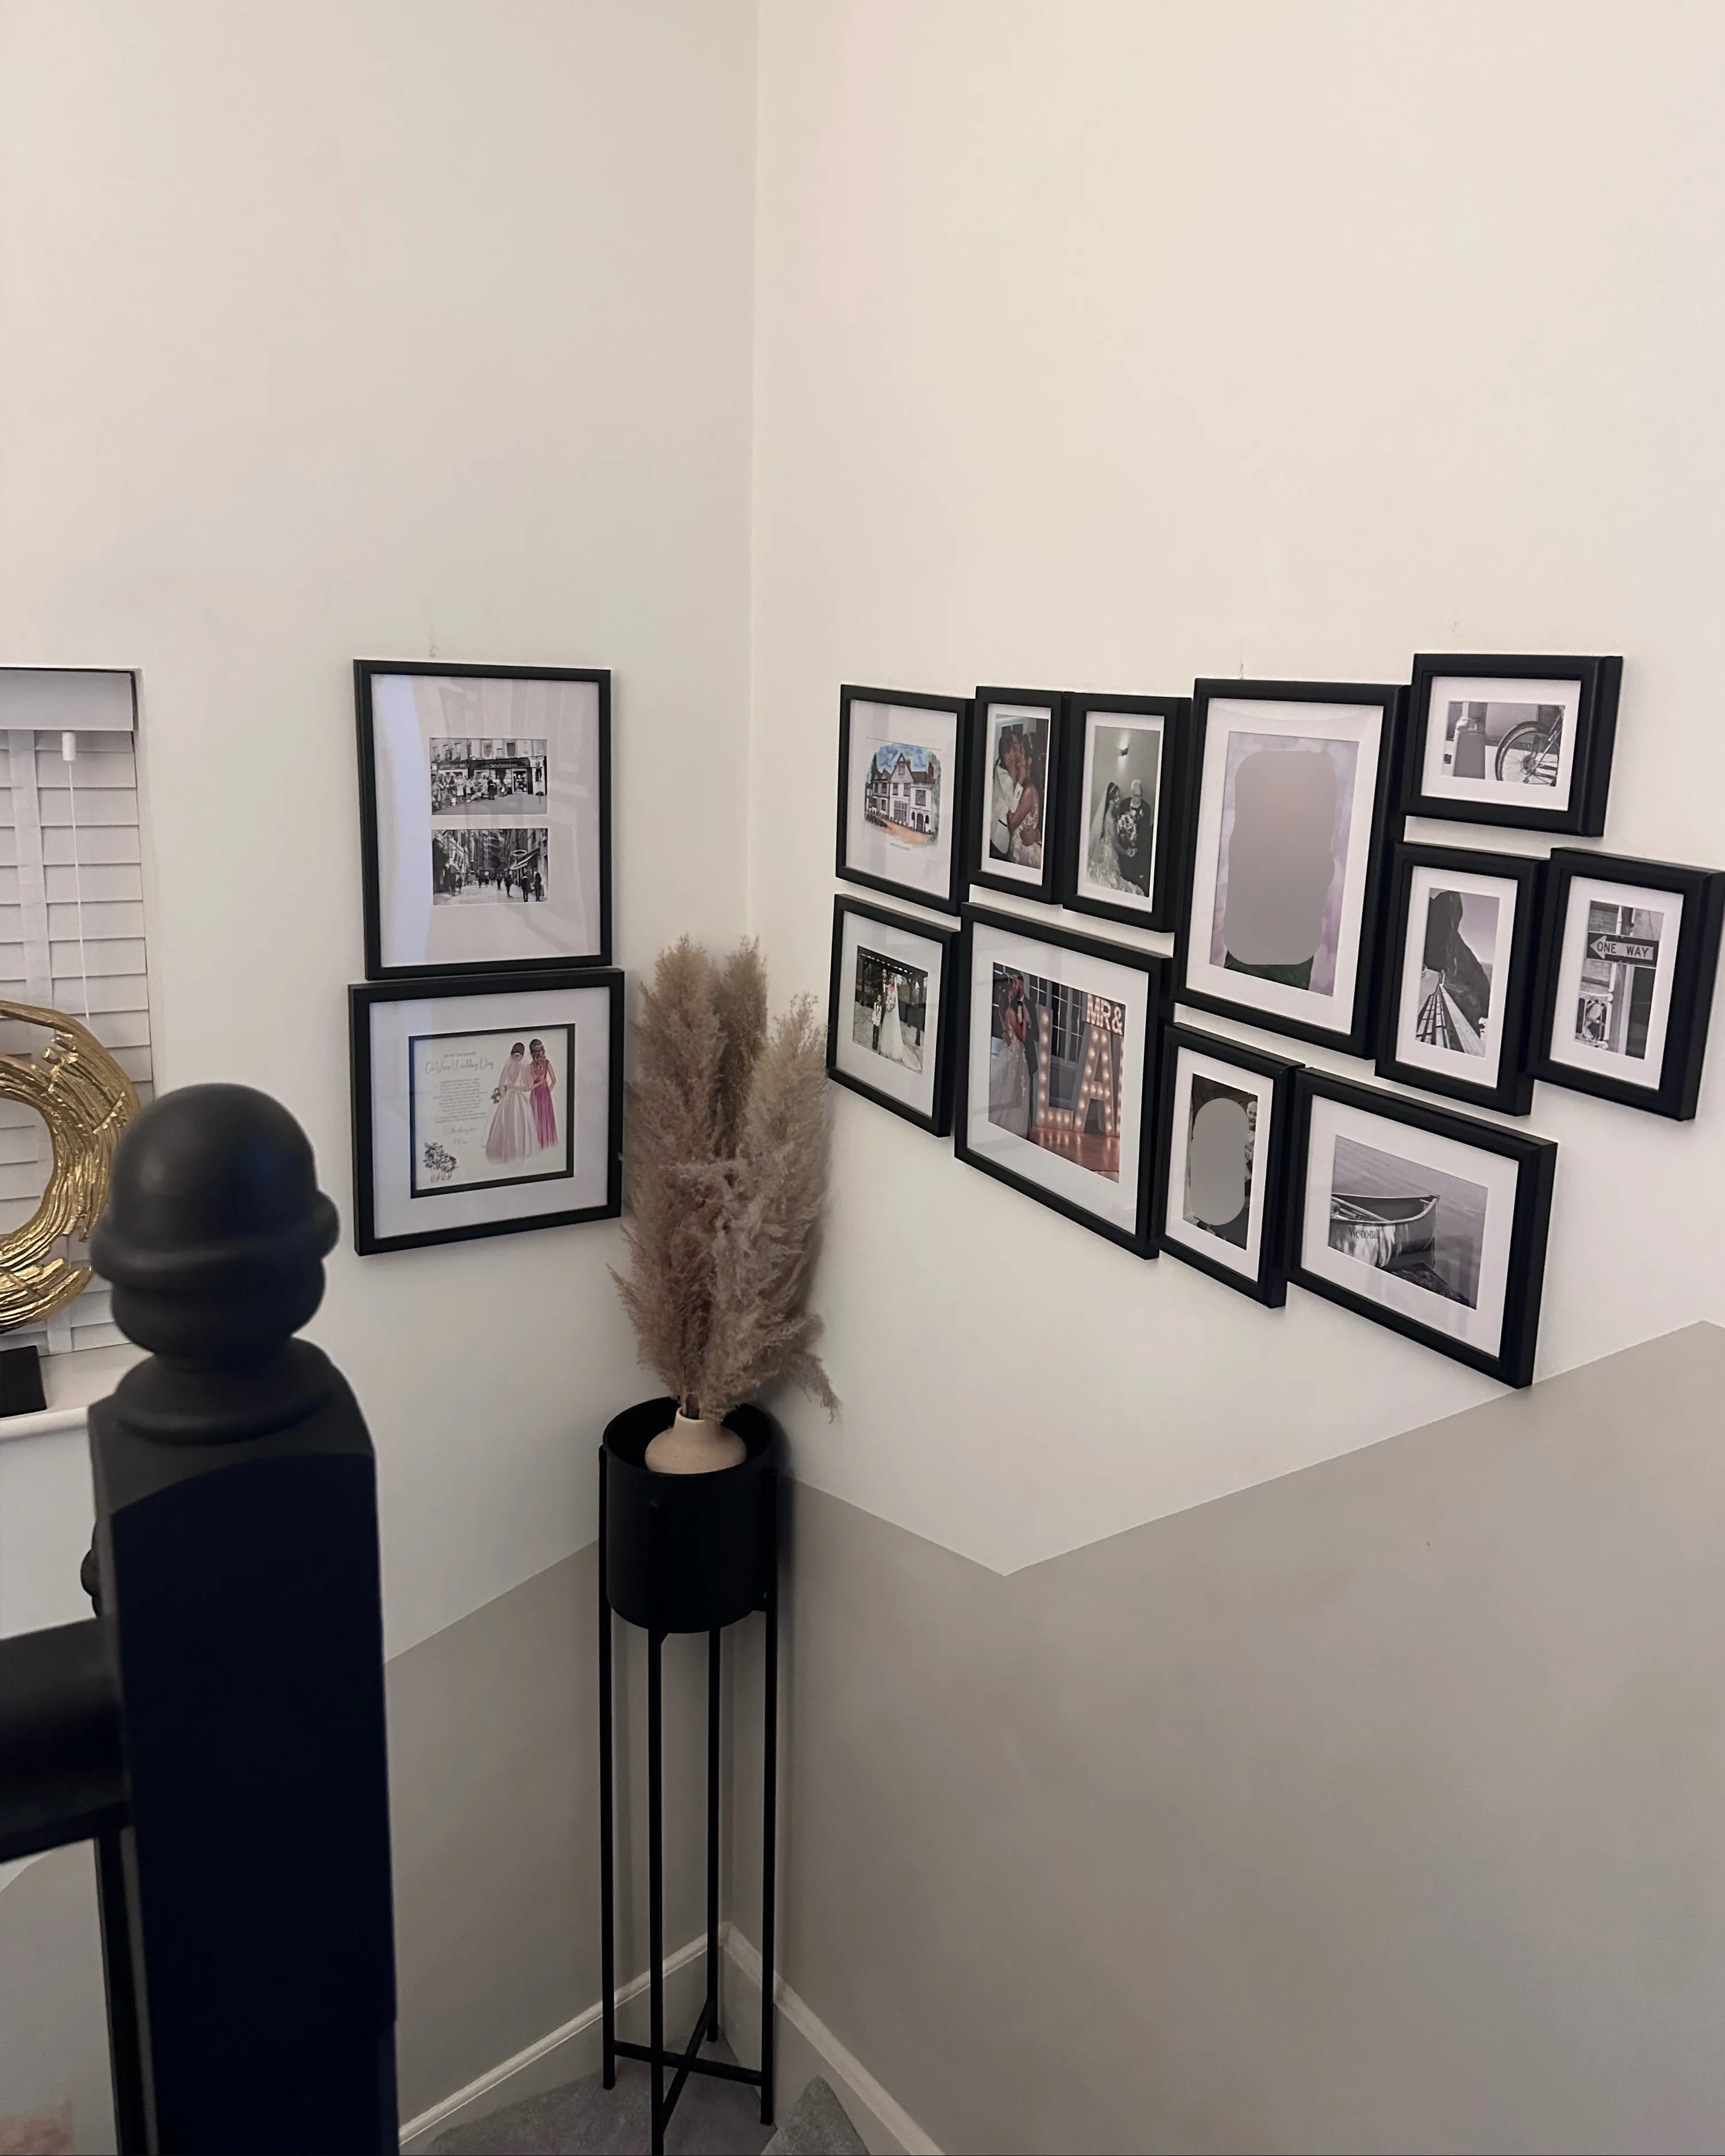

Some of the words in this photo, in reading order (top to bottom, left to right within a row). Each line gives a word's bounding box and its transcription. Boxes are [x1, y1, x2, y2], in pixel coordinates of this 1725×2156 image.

[1597, 942, 1617, 954] ONE
[1626, 945, 1650, 958] WAY
[1086, 993, 1111, 1032] MR
[1111, 1006, 1124, 1036] &
[1036, 1004, 1124, 1137] LA
